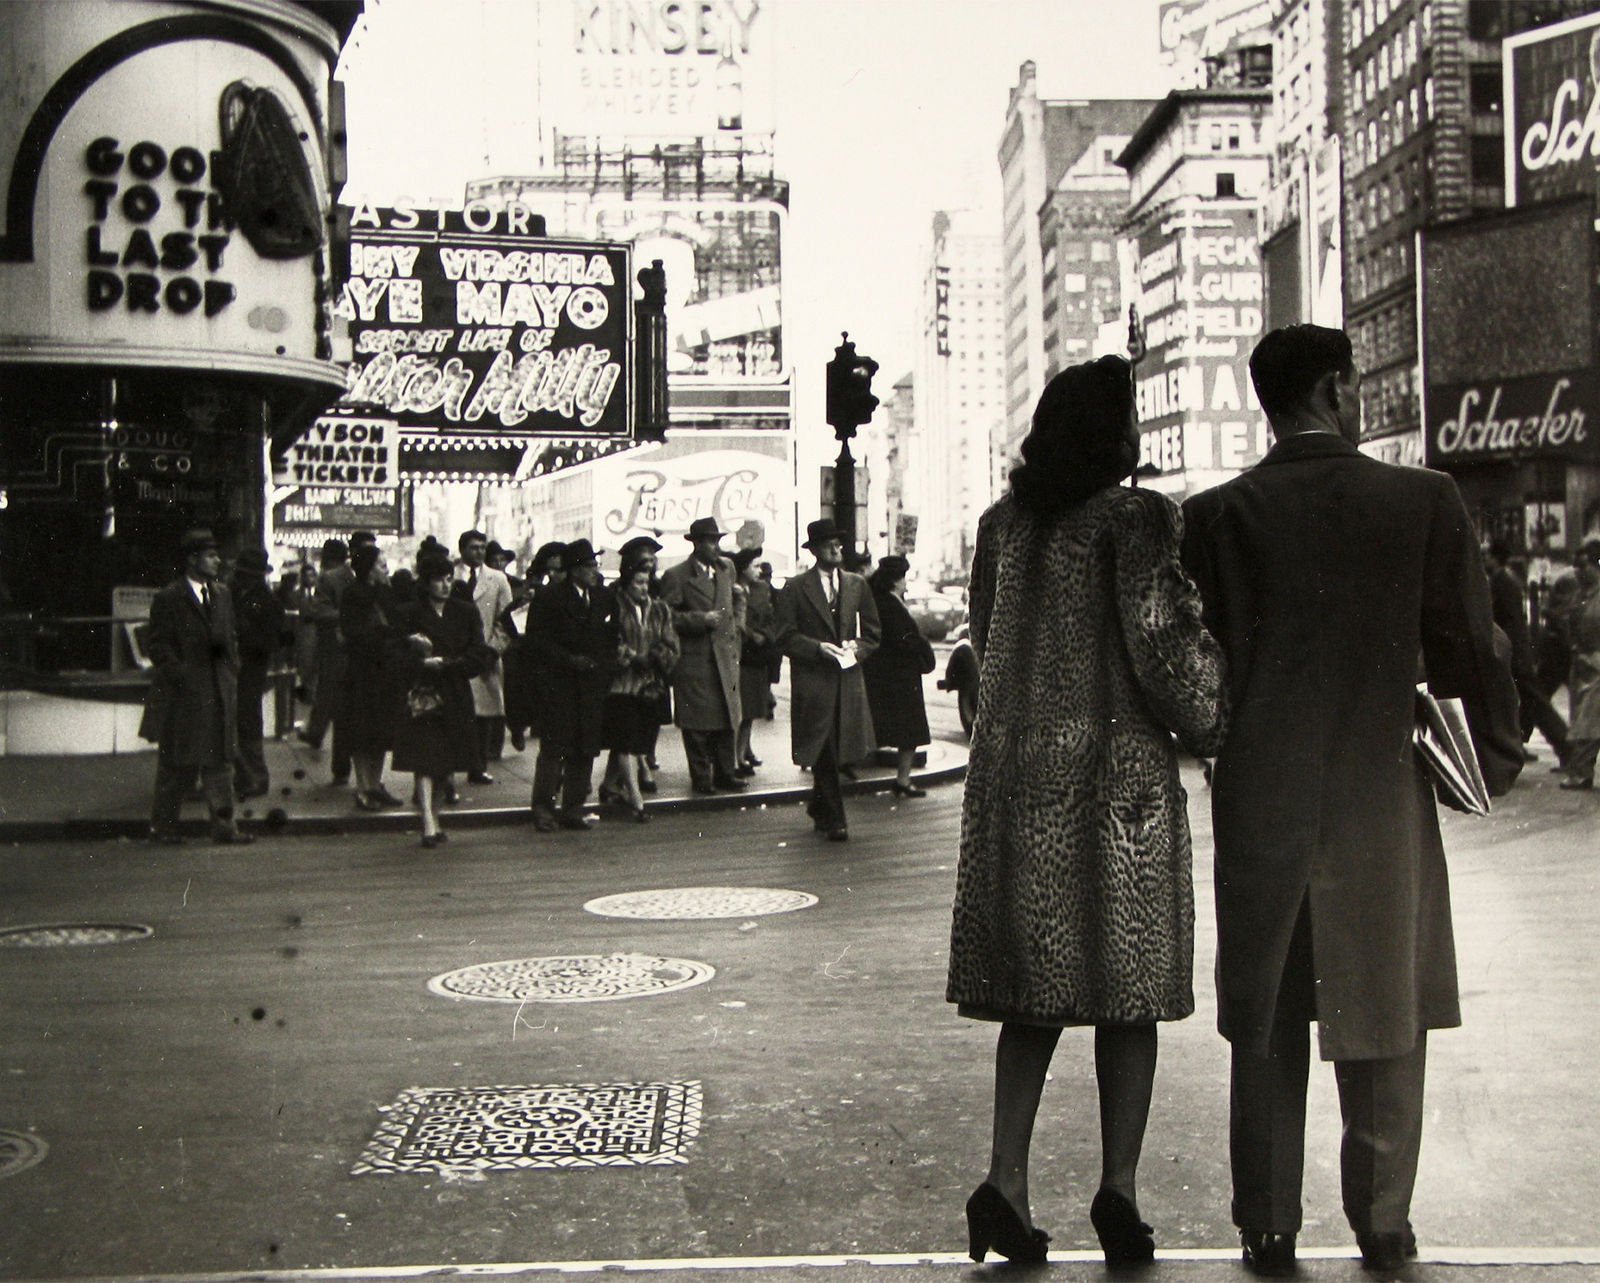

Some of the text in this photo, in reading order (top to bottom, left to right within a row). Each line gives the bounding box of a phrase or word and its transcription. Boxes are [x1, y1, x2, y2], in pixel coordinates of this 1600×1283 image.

[573, 0, 761, 55] KINSEY
[579, 66, 700, 88] BLENDED
[85, 179, 160, 223] TO
[350, 194, 532, 235] ASTOR
[87, 225, 230, 273] LAST
[439, 248, 615, 286] VIRGINIA
[1181, 235, 1259, 266] PECK
[86, 270, 237, 318] DROP
[456, 281, 609, 330] MAYO
[355, 329, 556, 353] SECRET LIFE OF
[1437, 377, 1588, 454] Schaefer
[292, 463, 388, 485] TICKETS
[294, 443, 388, 464] THEATRE
